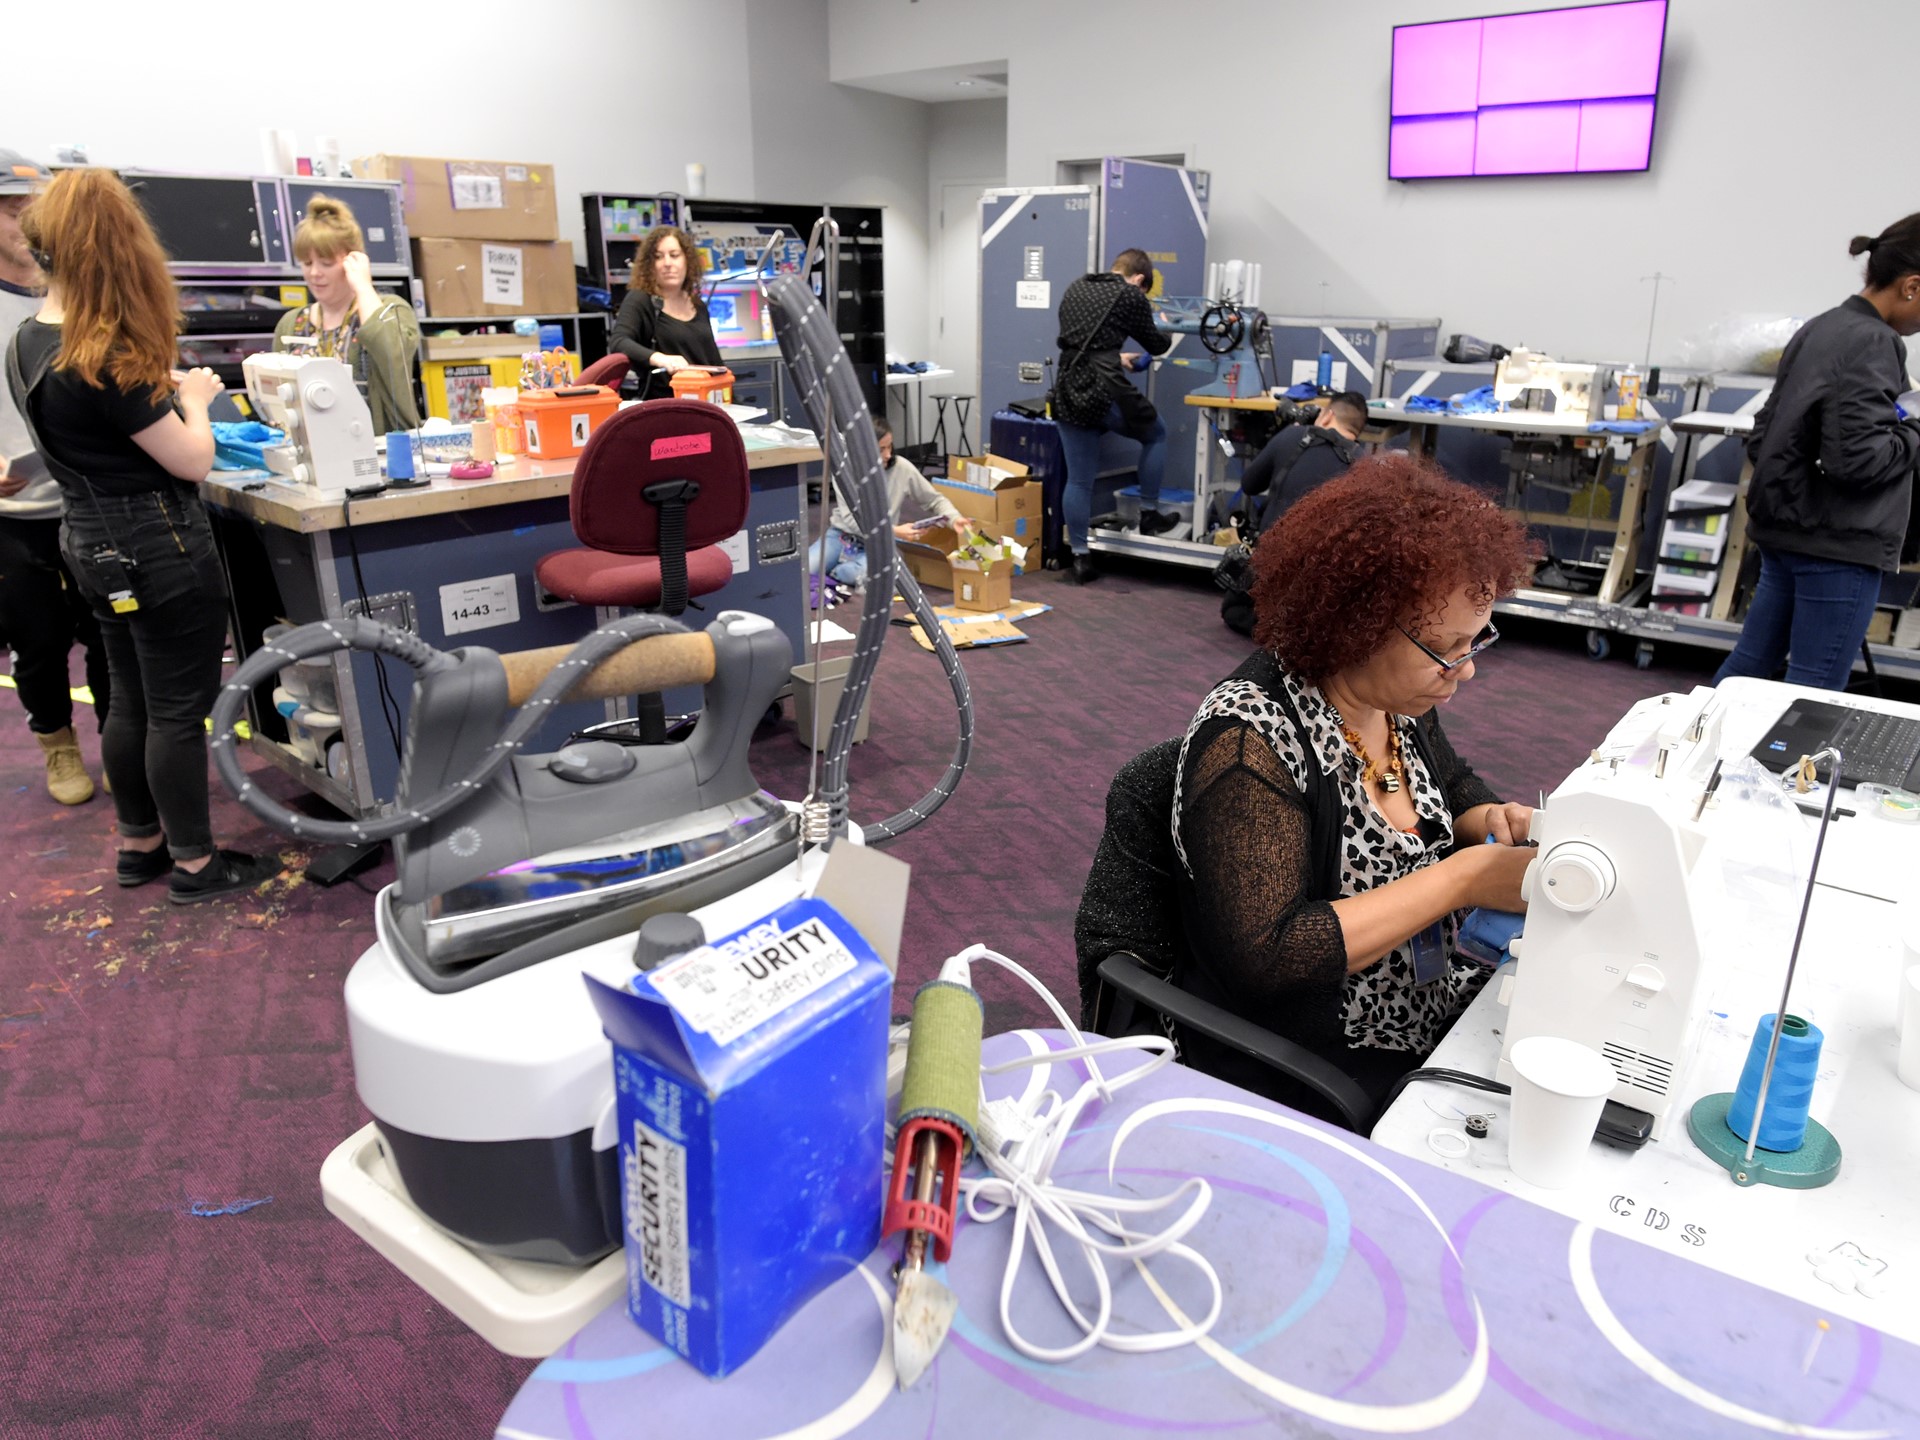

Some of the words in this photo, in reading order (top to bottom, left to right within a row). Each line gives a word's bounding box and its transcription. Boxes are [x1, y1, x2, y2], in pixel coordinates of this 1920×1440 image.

[654, 441, 700, 456] Wardrobe
[451, 604, 490, 620] 14-43
[734, 922, 828, 985] URITY
[757, 968, 812, 1007] safety
[811, 947, 849, 977] pins
[639, 1128, 662, 1287] SECURITY
[1609, 1195, 1706, 1246] CDS
